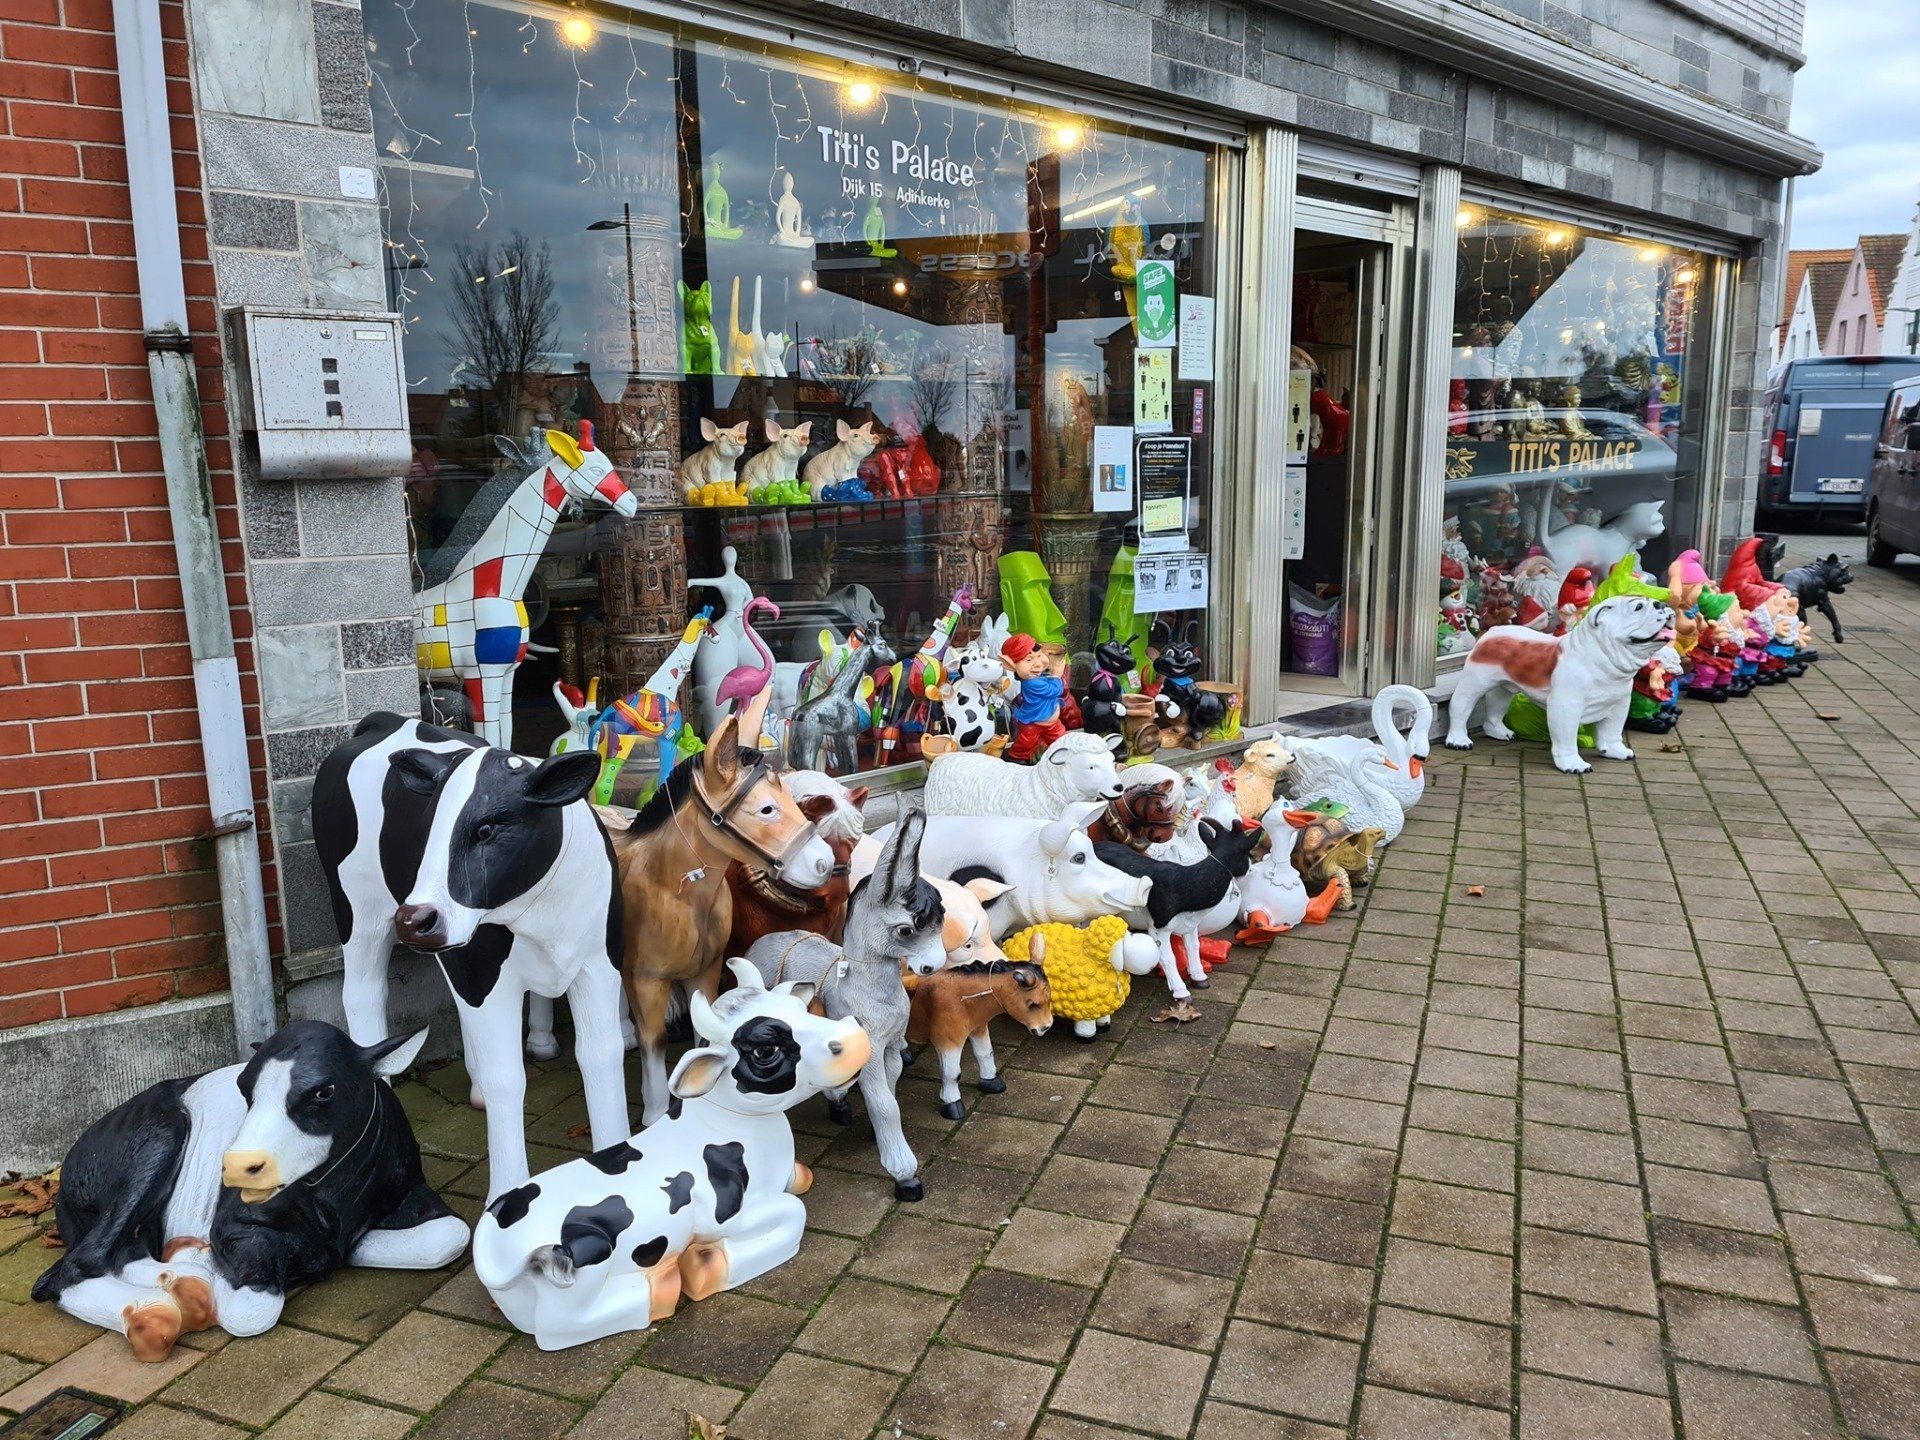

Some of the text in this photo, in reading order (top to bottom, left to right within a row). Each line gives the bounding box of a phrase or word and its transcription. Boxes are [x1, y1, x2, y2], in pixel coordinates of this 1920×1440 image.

[817, 125, 974, 187] Titi's Palace
[842, 176, 951, 210] Dijk 15 Adinkerke
[1508, 440, 1635, 474] TITI'S PALACE
